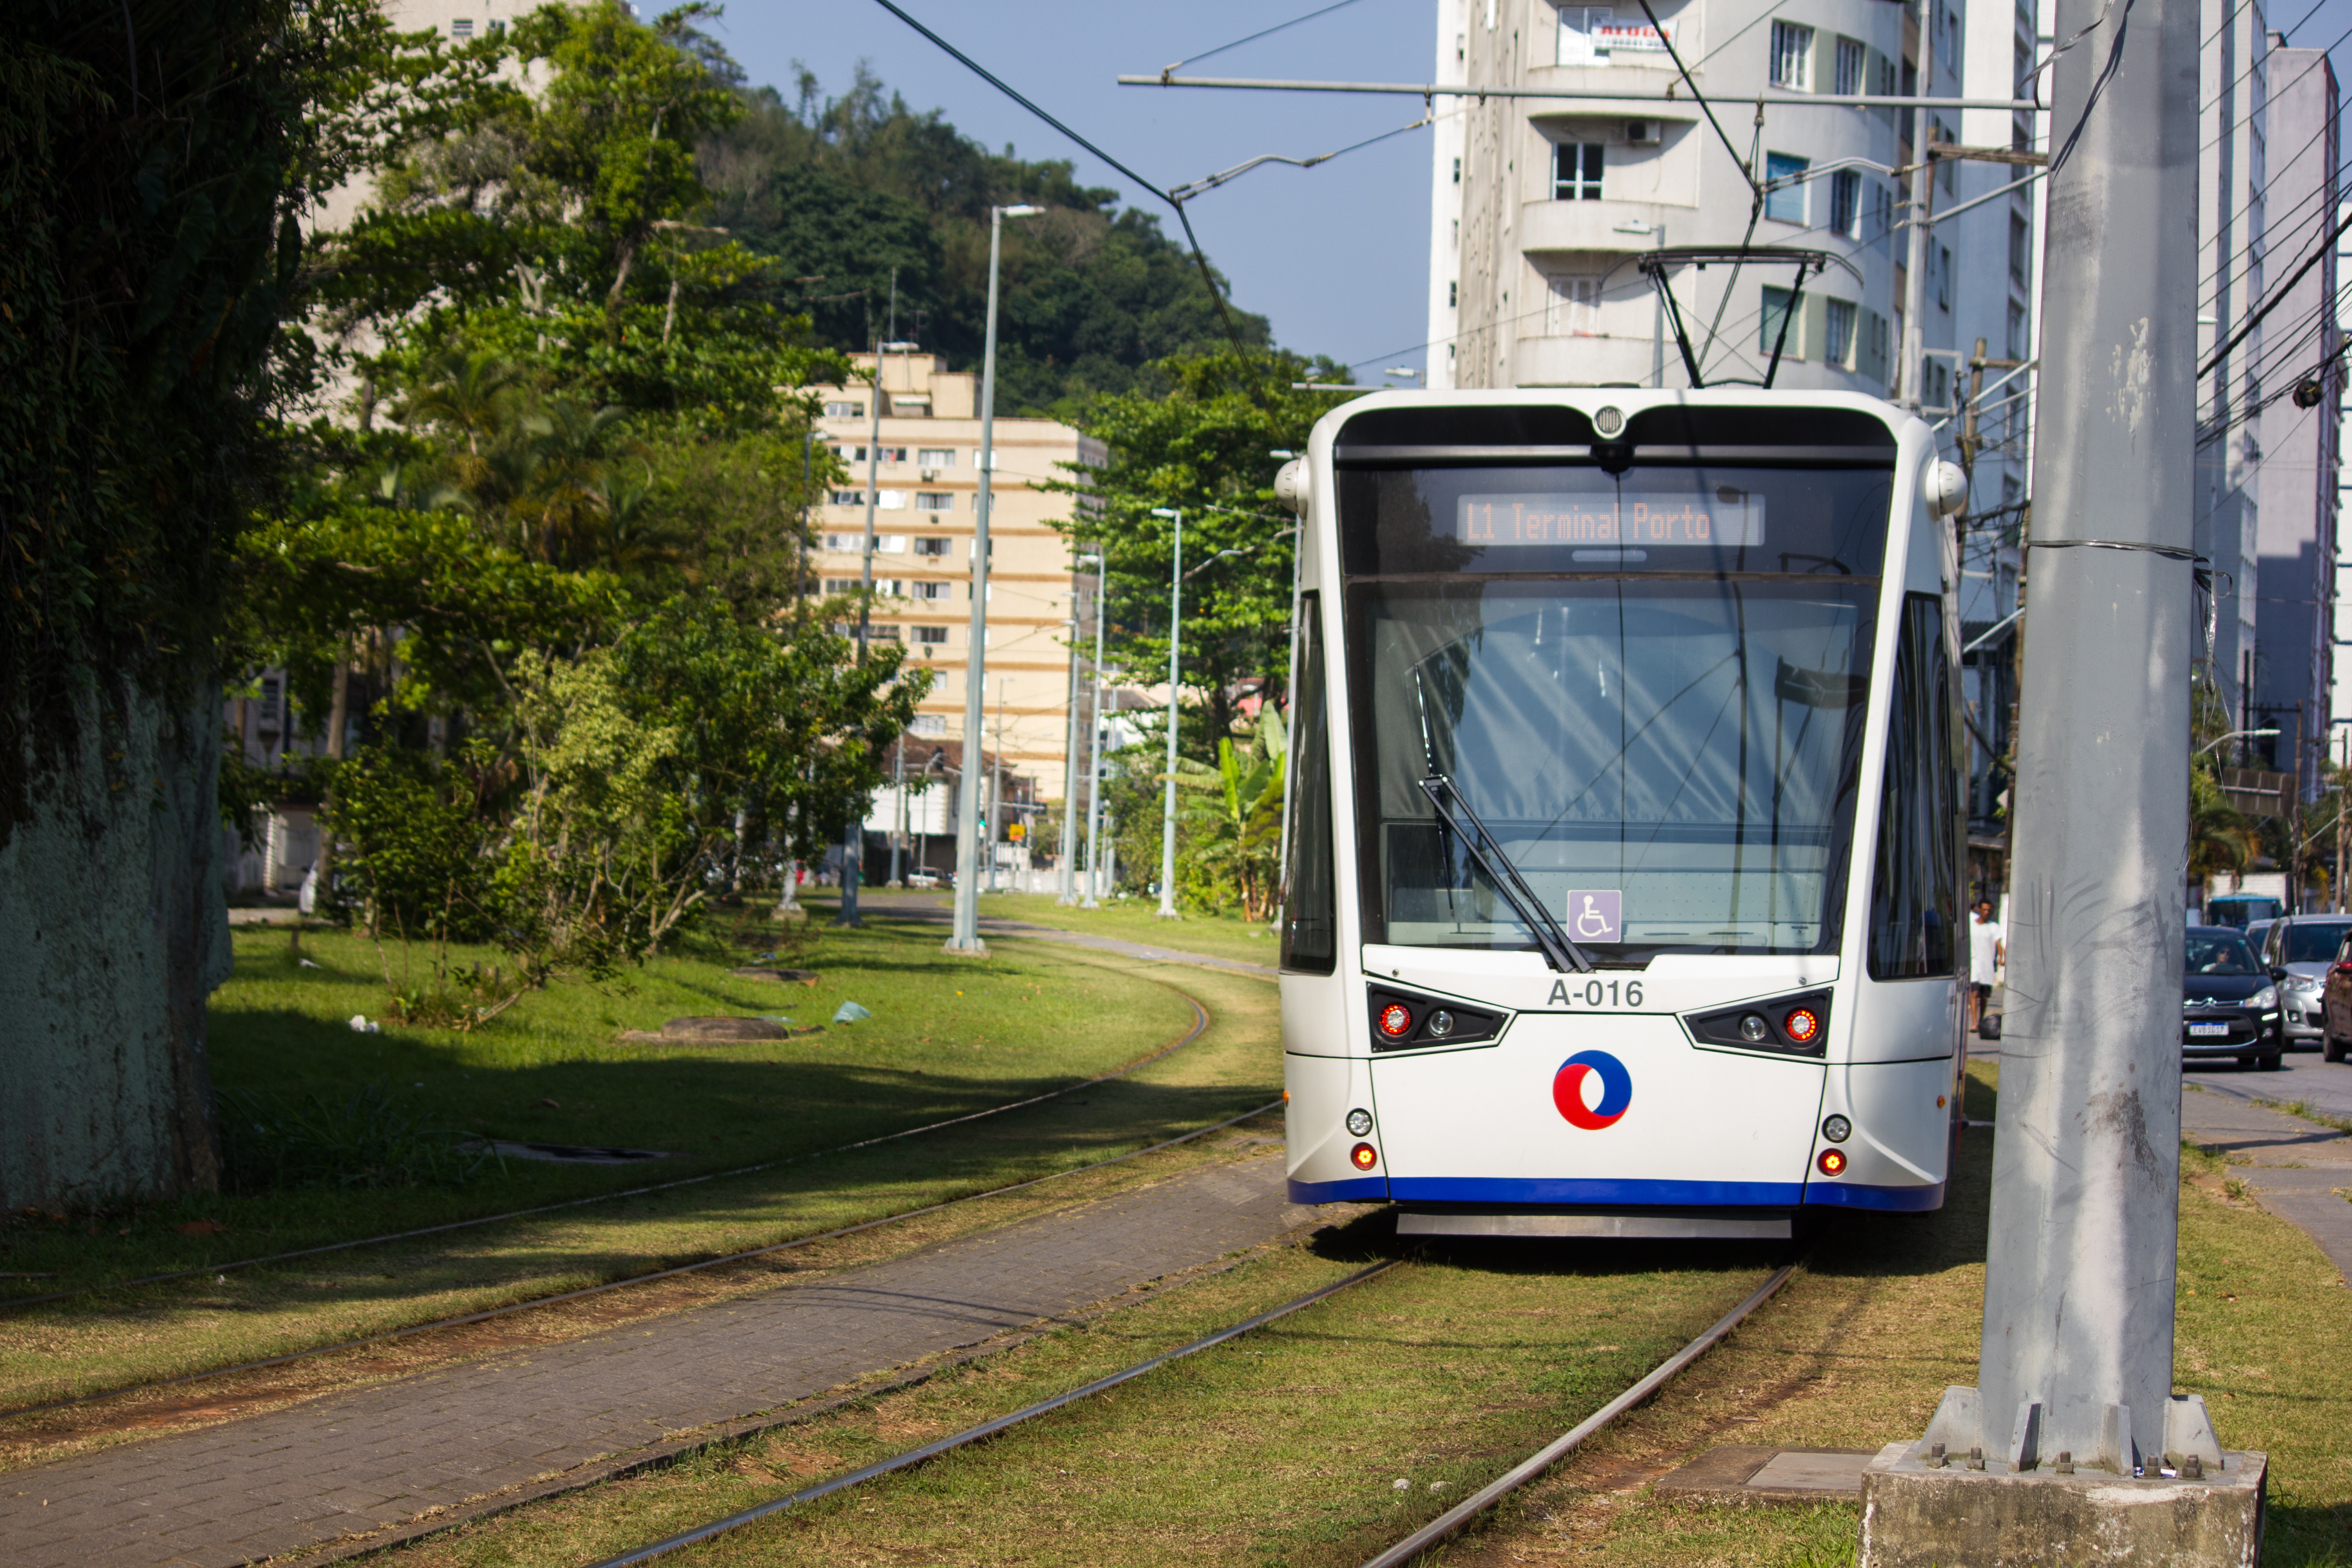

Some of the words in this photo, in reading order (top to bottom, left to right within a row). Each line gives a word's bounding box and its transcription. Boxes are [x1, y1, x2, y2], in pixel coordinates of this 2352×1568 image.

[1467, 502, 1495, 540] L1
[1512, 502, 1619, 540] Terminal
[1633, 502, 1710, 539] Porto
[1547, 979, 1643, 1007] A-016
